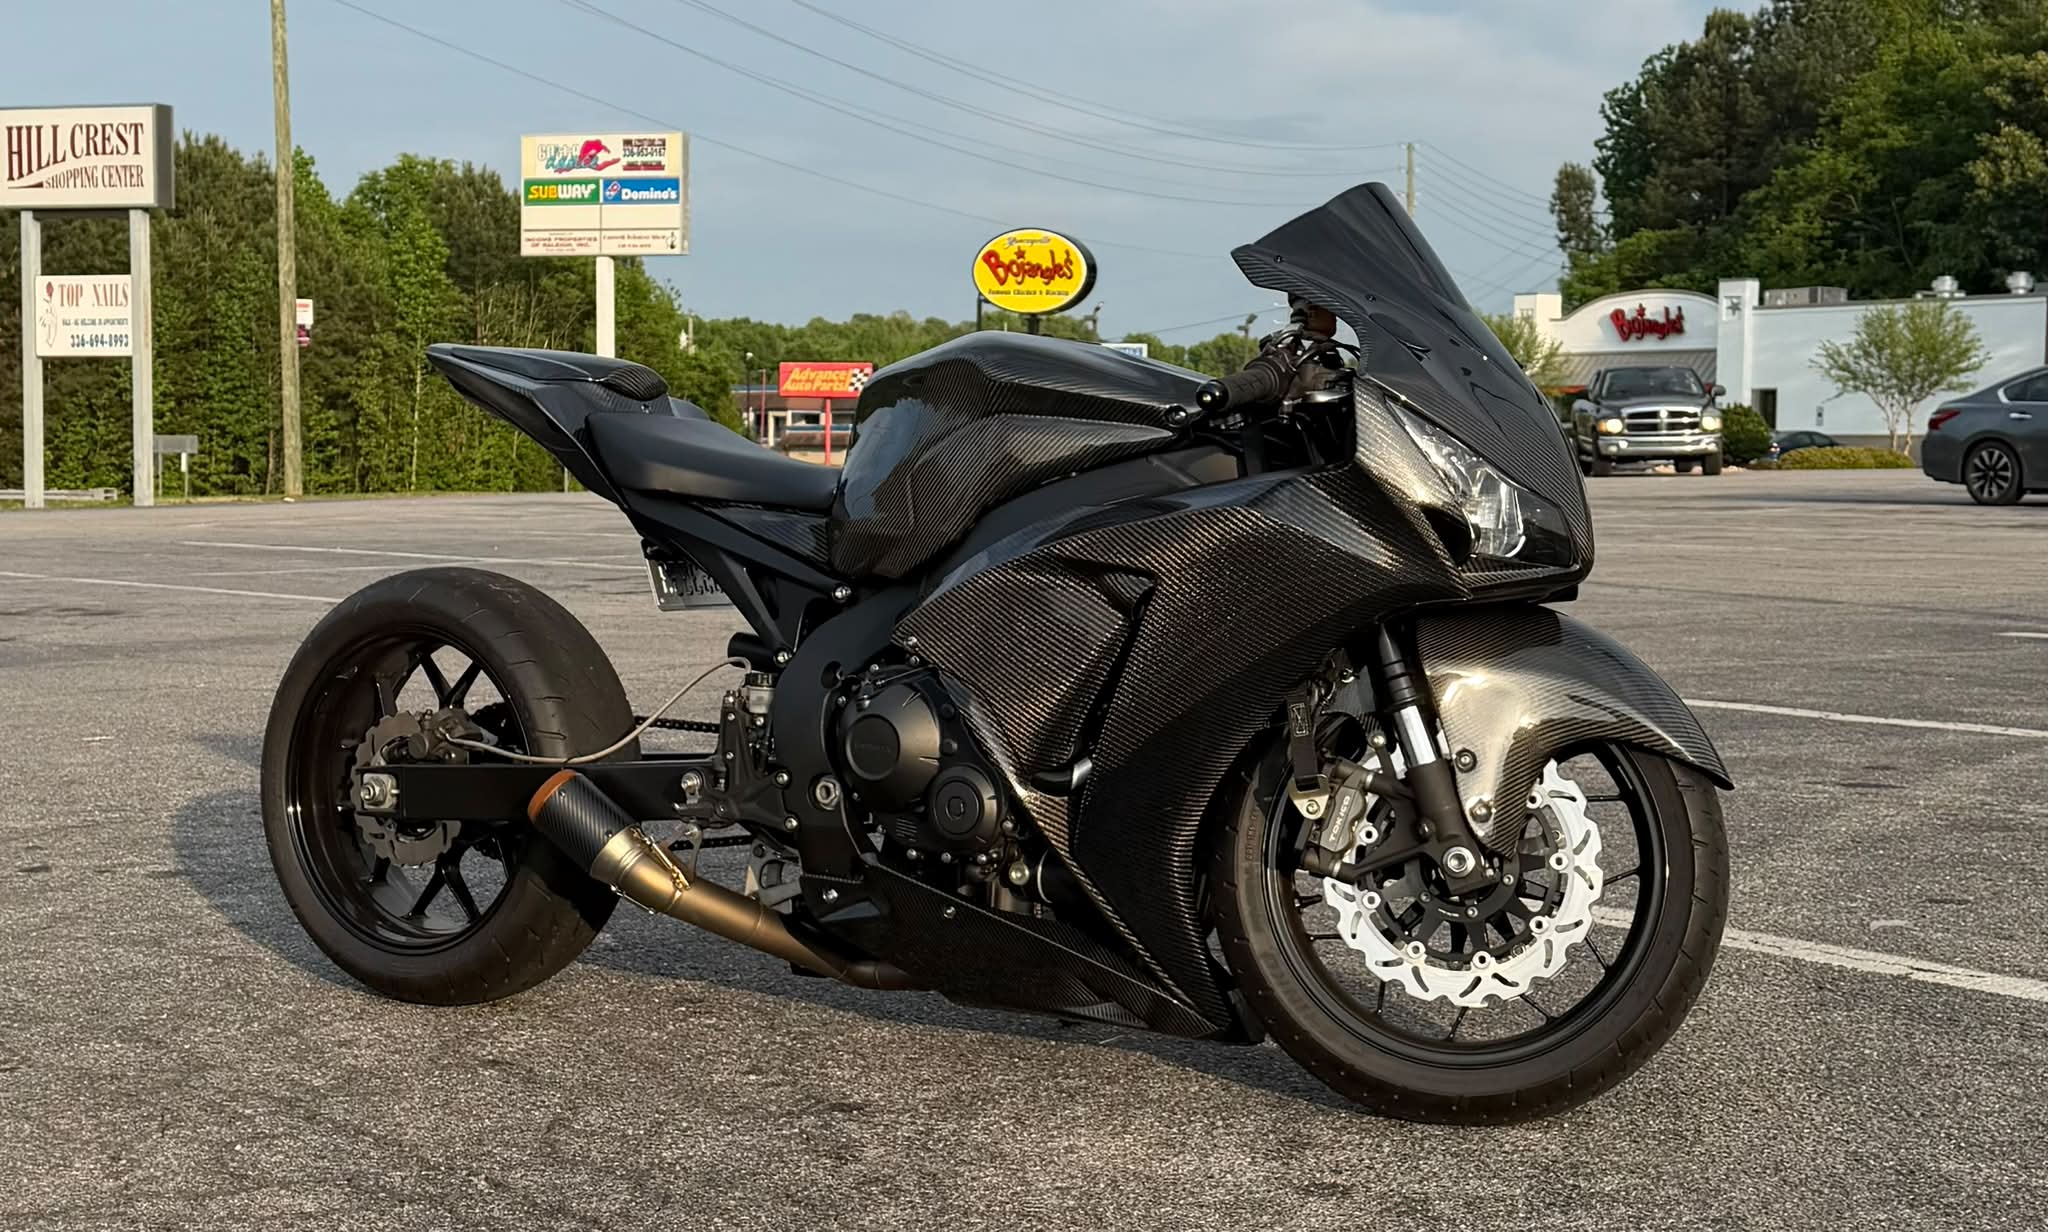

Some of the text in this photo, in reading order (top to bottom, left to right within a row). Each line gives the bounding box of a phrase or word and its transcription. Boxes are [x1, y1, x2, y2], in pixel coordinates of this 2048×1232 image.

[45, 165, 144, 189] SHOPPING CENTER
[528, 184, 597, 199] SUBWAY
[621, 188, 677, 201] Domino's
[58, 283, 129, 308] TOP NAILS
[70, 333, 129, 348] 336-694-8993
[790, 368, 848, 380] Advance
[782, 380, 812, 391] Auto
